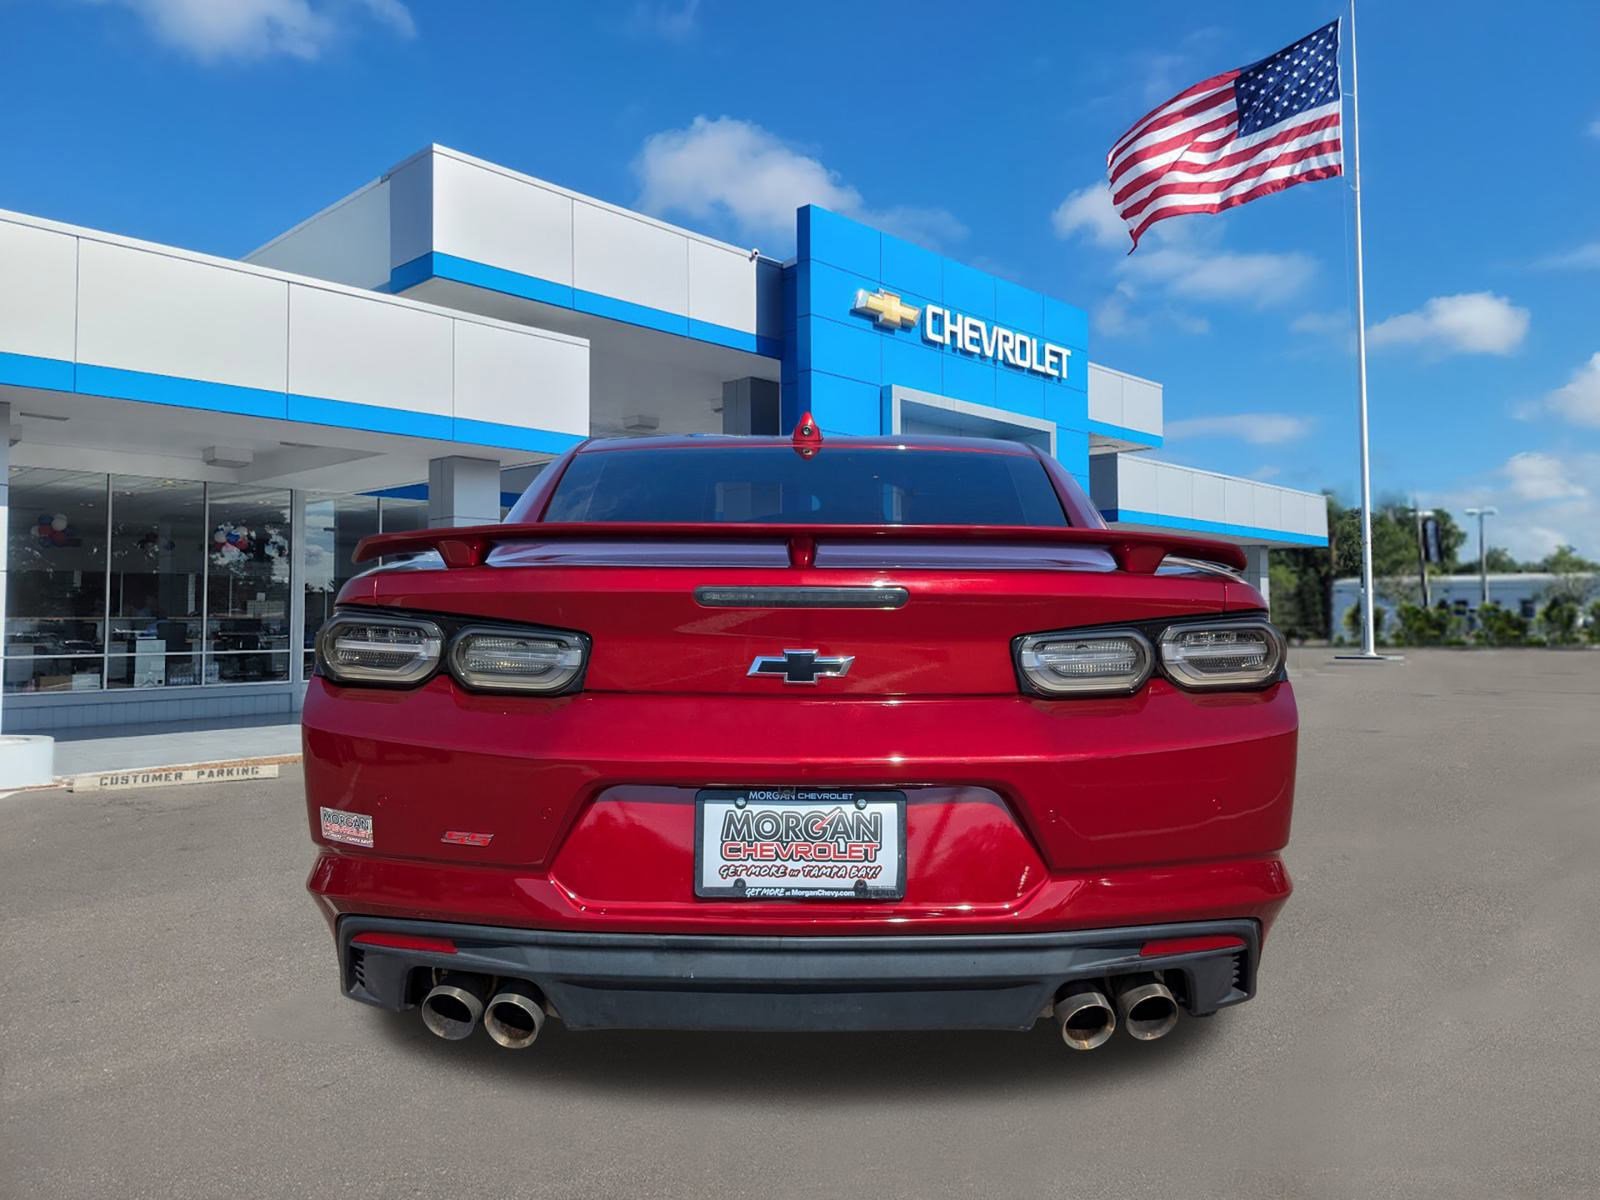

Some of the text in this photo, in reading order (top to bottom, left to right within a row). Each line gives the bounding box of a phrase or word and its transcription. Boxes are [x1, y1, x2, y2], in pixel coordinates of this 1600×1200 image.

[925, 304, 1072, 379] CHEVROLET
[100, 766, 260, 787] CUSTOMER PARKING
[748, 791, 796, 800] MORGAN
[323, 811, 370, 830] MORGAN
[721, 808, 883, 843] MORGAN
[441, 831, 494, 846] SS
[721, 841, 882, 861] CHEVROLET
[719, 864, 746, 879] GET
[746, 864, 787, 877] MORE
[801, 864, 846, 878] TAMPA
[849, 865, 882, 879] BAY!
[745, 888, 764, 898] GET
[761, 888, 785, 896] MORE
[791, 889, 856, 897] MorganChevy.com
